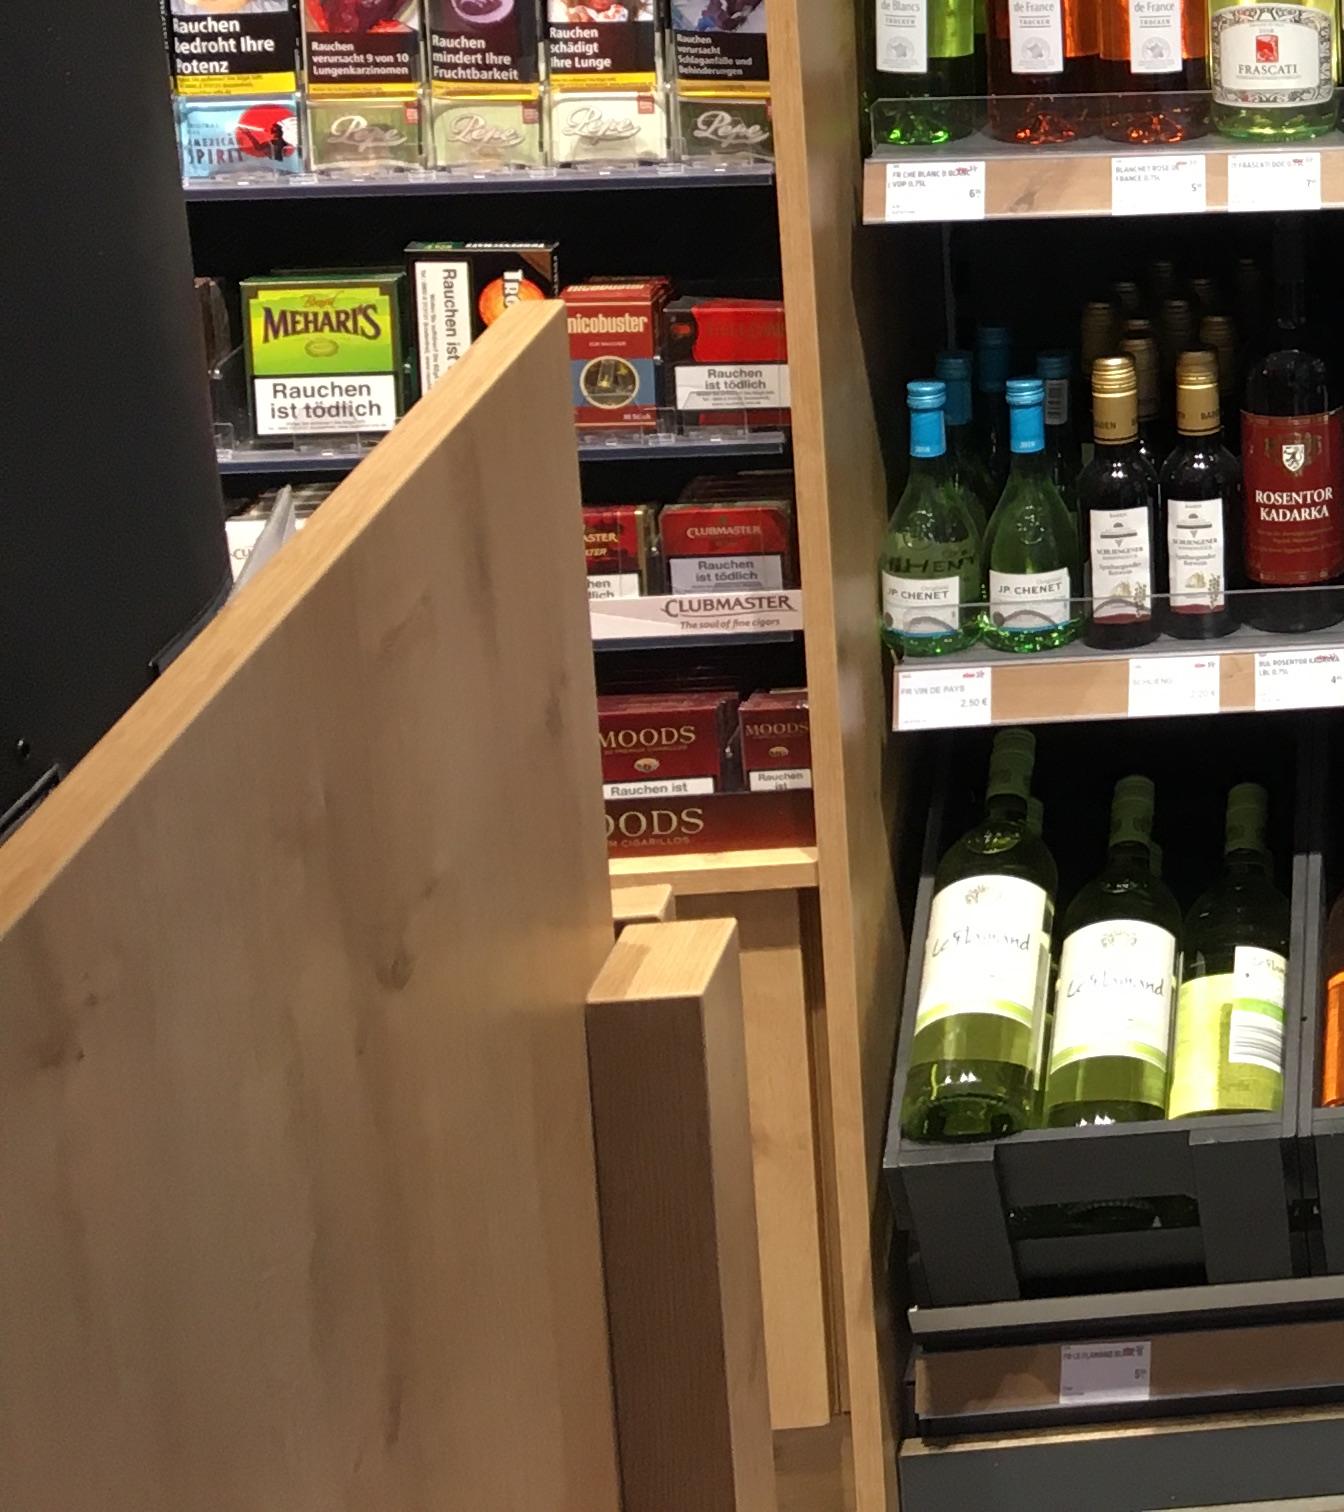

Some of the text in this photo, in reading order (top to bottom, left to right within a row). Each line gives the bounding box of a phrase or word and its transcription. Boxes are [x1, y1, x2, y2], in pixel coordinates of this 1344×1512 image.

[881, 1, 921, 13] de Blancs
[1013, 1, 1055, 13] de France
[1238, 63, 1298, 75] FRASCATI
[567, 312, 649, 336] nicobuster
[272, 382, 371, 400] Rauchen
[271, 399, 381, 419] ist tödlich
[1255, 487, 1334, 504] ROSENTOR
[1260, 505, 1329, 522] KADARKA
[1014, 581, 1062, 594] CHENET
[660, 595, 799, 619] CLUBMASTER
[752, 618, 780, 629] cigars
[599, 726, 696, 748] MOODS
